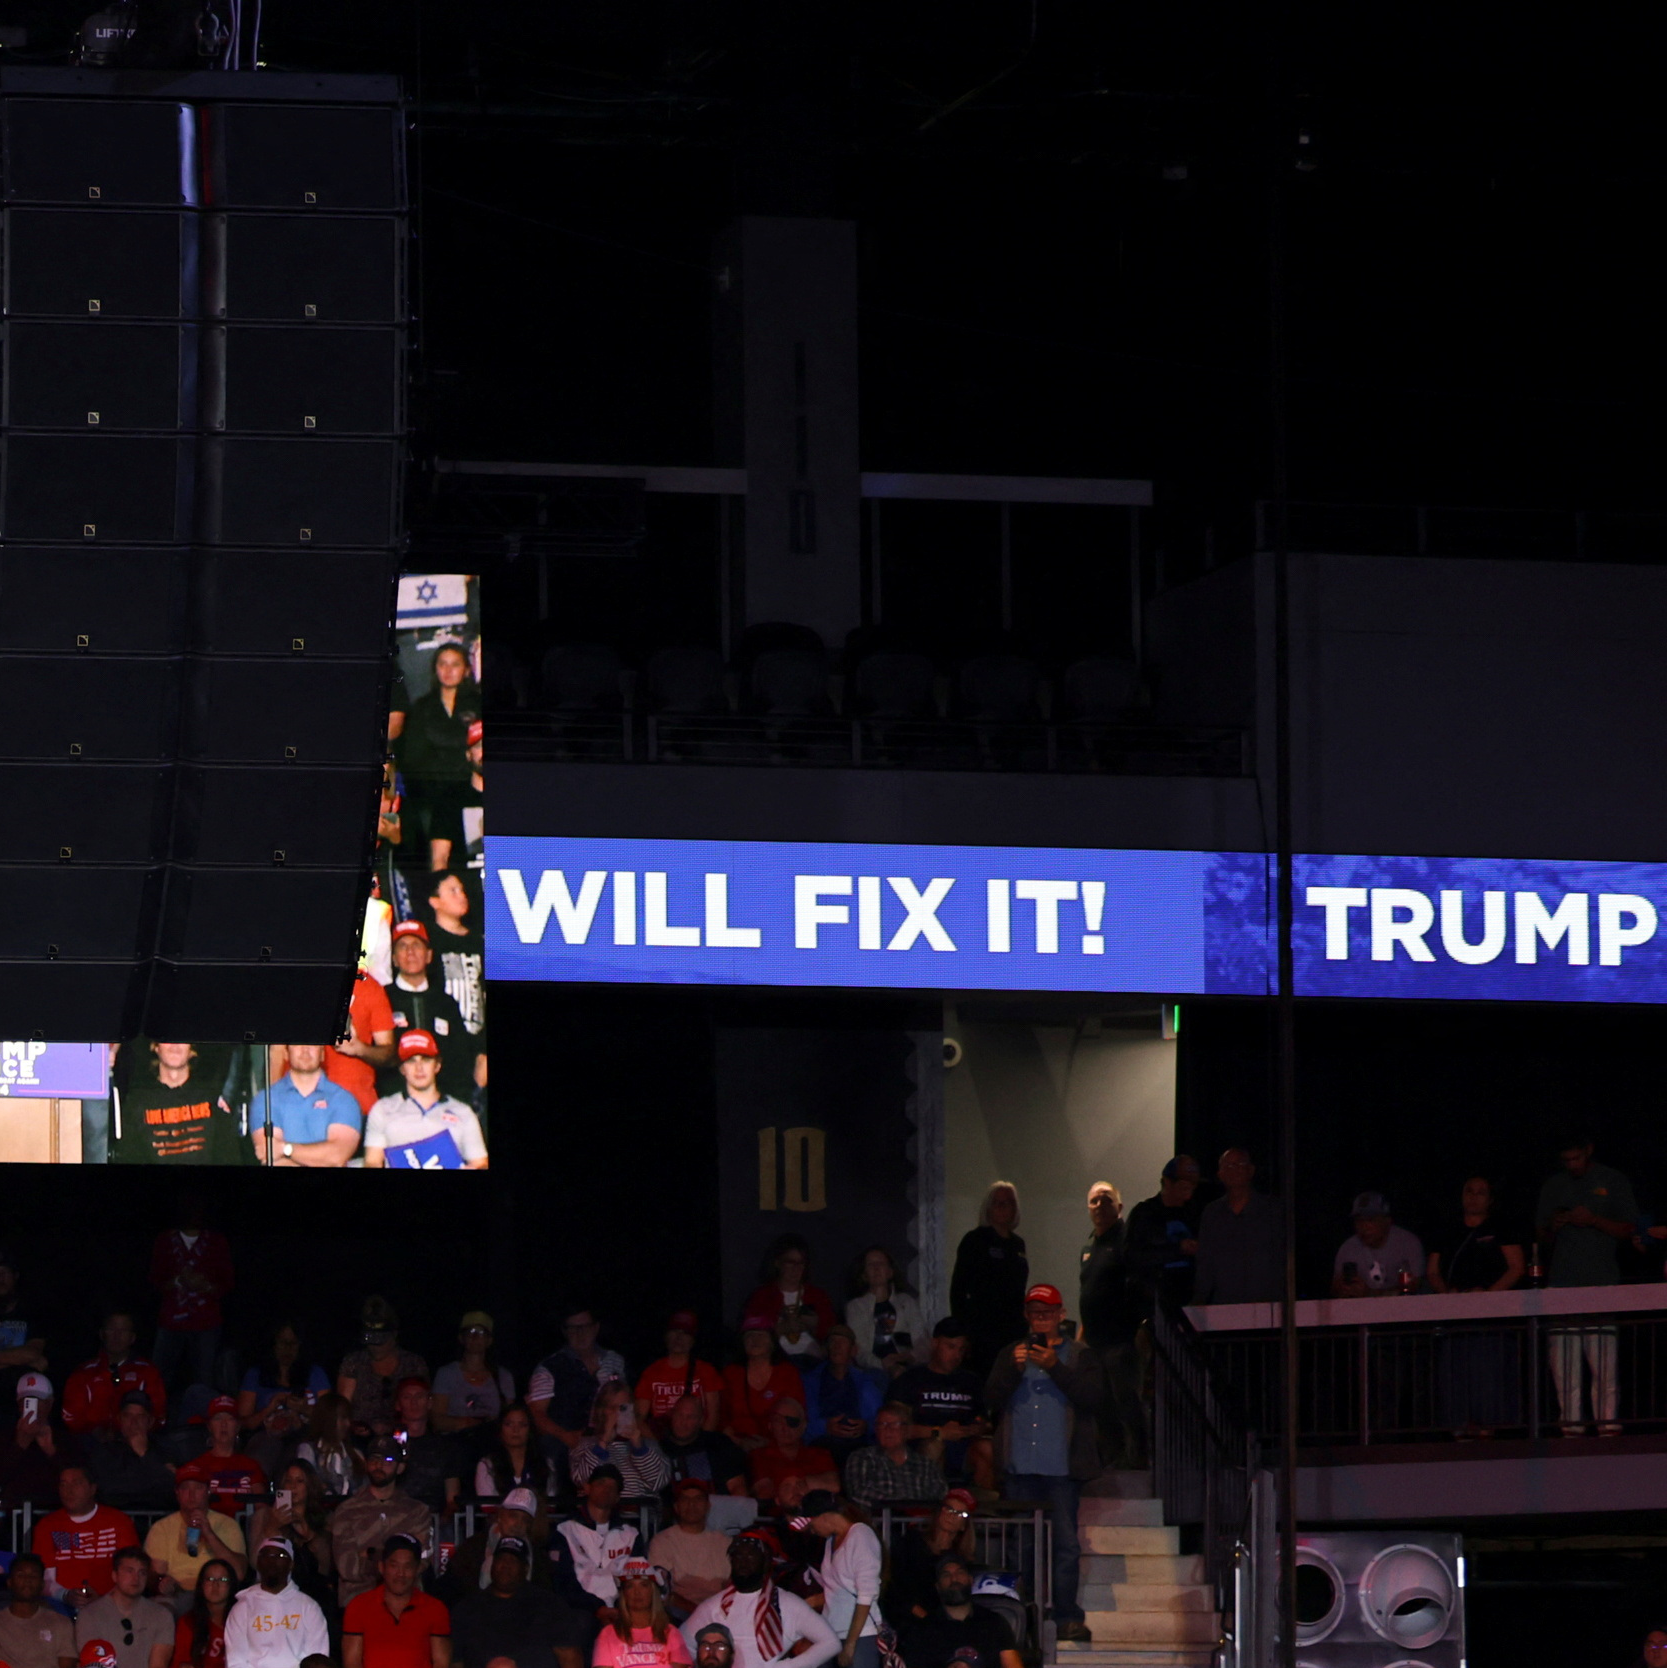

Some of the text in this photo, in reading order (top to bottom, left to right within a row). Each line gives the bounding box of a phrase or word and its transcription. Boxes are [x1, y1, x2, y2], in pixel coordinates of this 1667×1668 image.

[499, 868, 1107, 956] WILL FIX IT!
[1306, 886, 1658, 966] TRUMP
[758, 1126, 827, 1212] 10
[922, 1391, 973, 1401] TRUMP
[251, 1614, 302, 1633] 45-47
